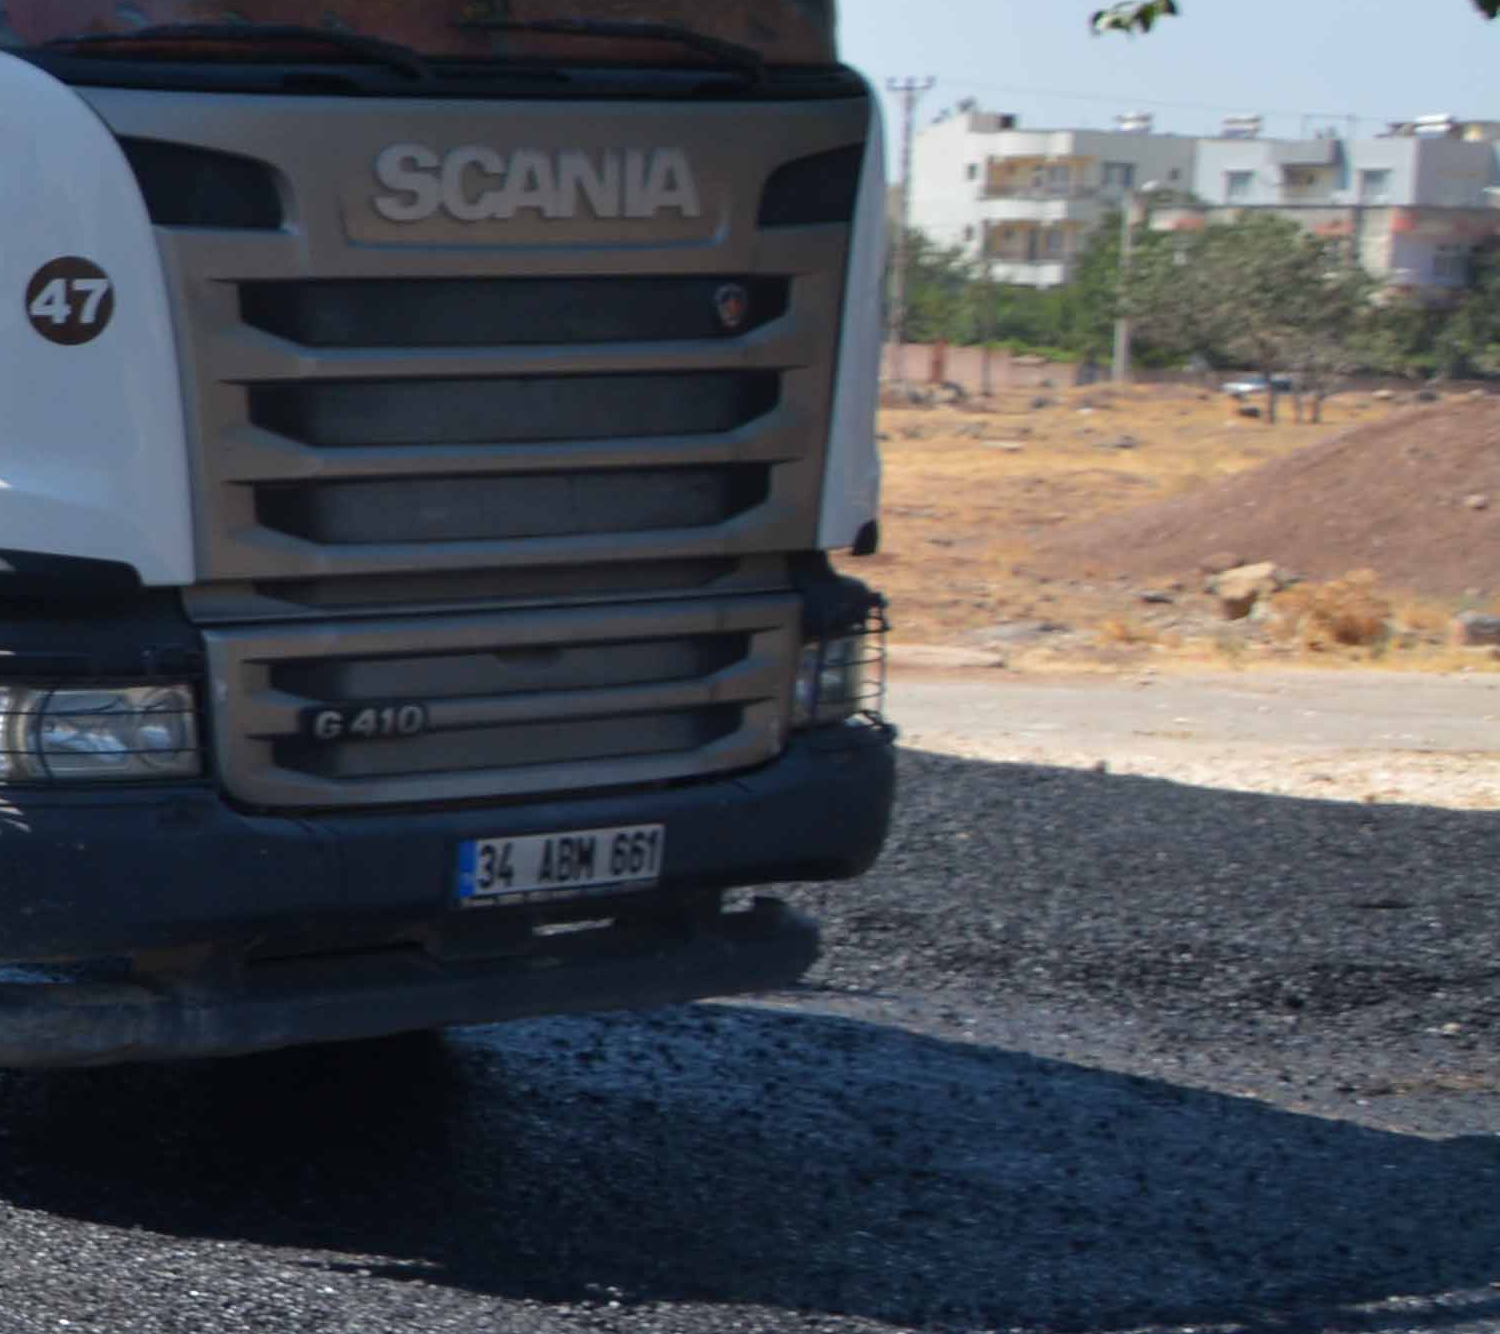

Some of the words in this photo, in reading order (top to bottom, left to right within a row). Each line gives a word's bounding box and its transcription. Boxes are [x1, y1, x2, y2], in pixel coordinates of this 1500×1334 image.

[373, 143, 700, 221] SCANIA
[30, 278, 109, 324] 47
[315, 710, 343, 740] G
[351, 704, 425, 738] 410
[477, 842, 514, 889] 34
[537, 834, 597, 884] ABM
[610, 828, 660, 877] 661
